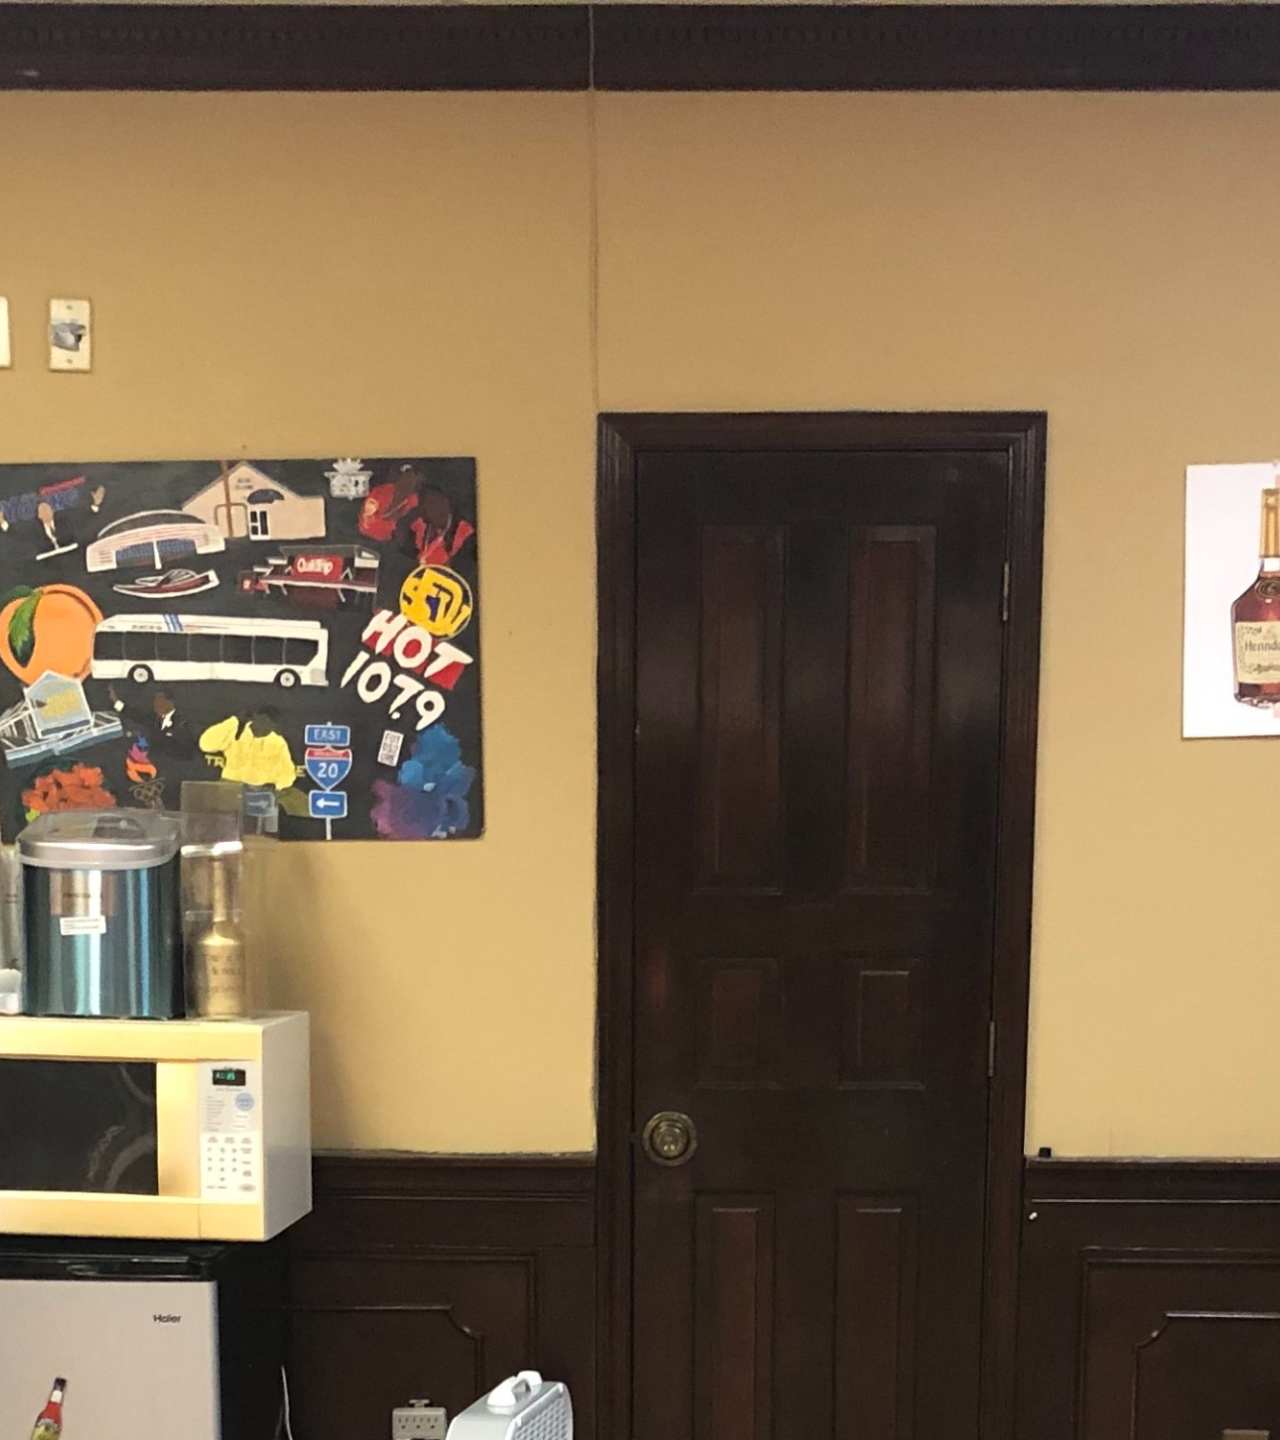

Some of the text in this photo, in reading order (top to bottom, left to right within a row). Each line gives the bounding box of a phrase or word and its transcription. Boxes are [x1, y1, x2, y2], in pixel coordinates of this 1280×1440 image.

[361, 609, 474, 678] HOT
[340, 650, 446, 731] 107.9
[313, 728, 342, 741] EAST
[317, 762, 338, 778] 20
[153, 1313, 181, 1324] Haier
